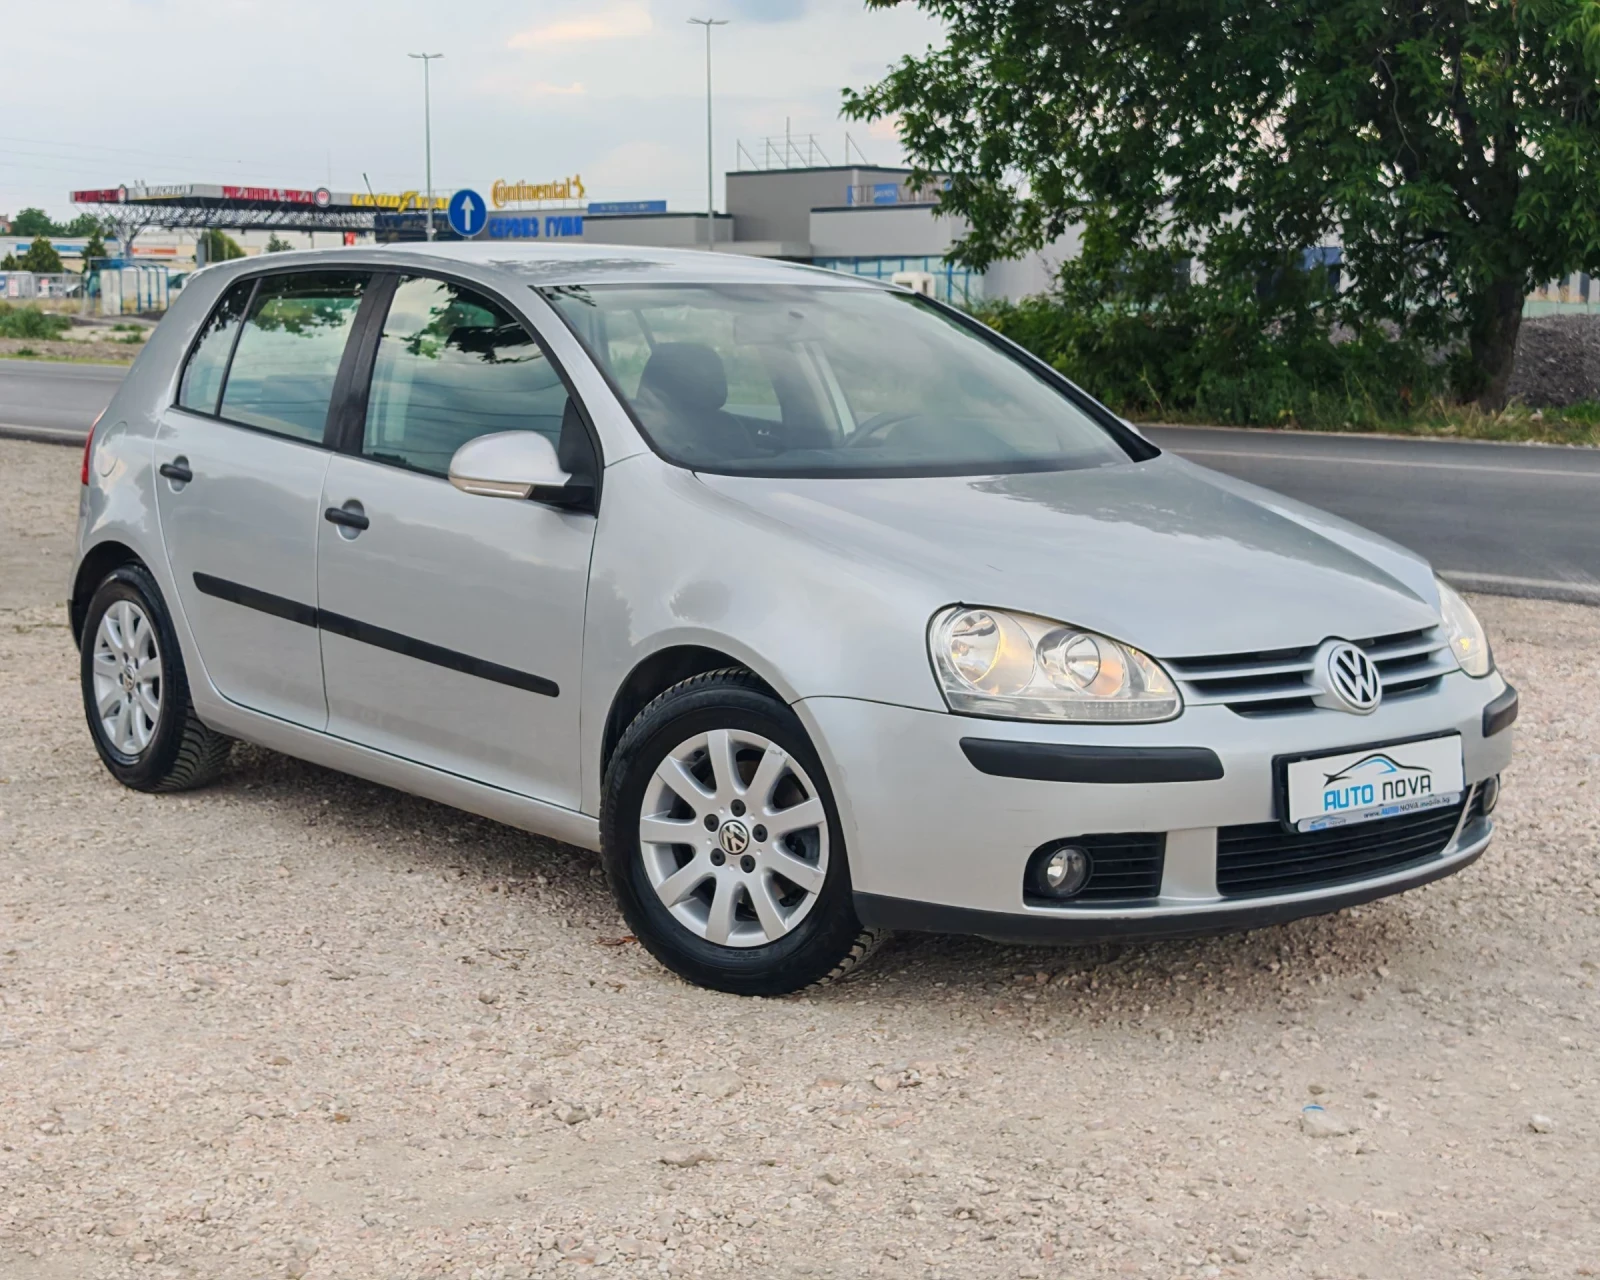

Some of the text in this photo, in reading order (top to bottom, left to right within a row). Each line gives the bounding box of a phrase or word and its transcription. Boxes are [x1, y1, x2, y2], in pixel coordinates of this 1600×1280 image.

[492, 177, 570, 208] Continental
[1323, 774, 1432, 811] AUTO NOVA
